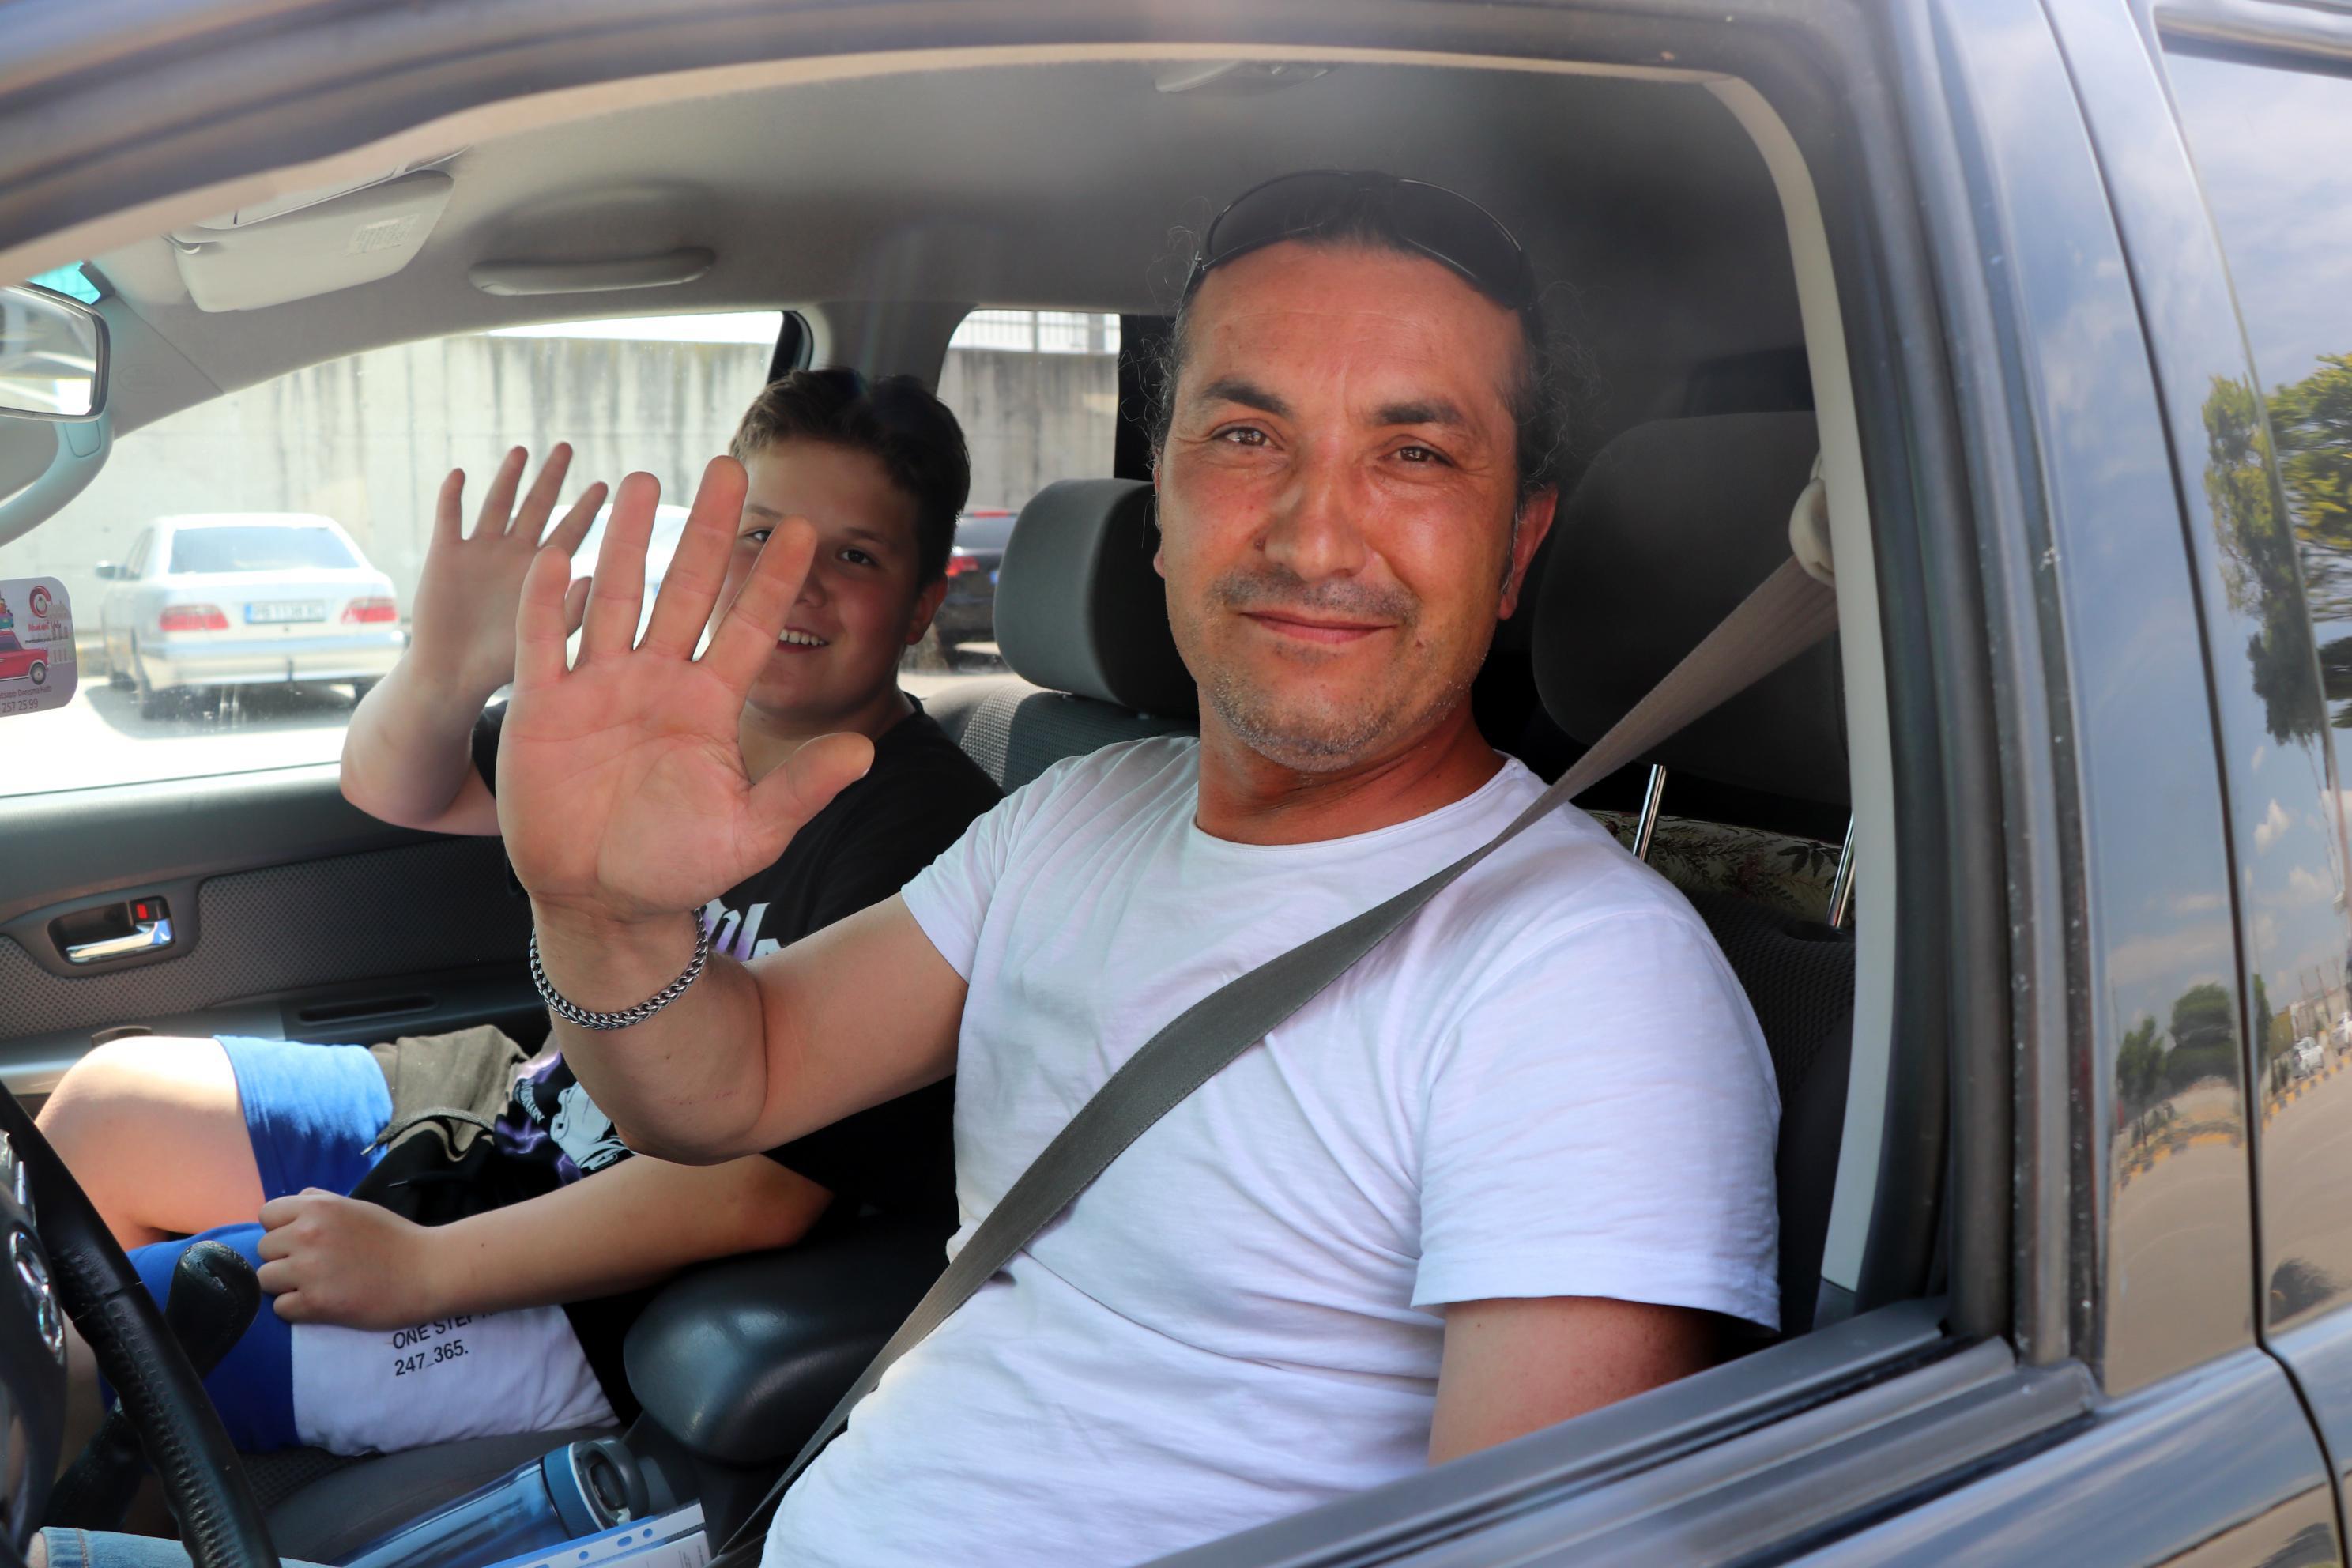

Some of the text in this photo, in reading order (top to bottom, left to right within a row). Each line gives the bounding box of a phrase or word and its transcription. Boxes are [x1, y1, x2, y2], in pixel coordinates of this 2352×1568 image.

[2, 698, 39, 713] 257 25 99
[393, 1324, 431, 1349] ONE
